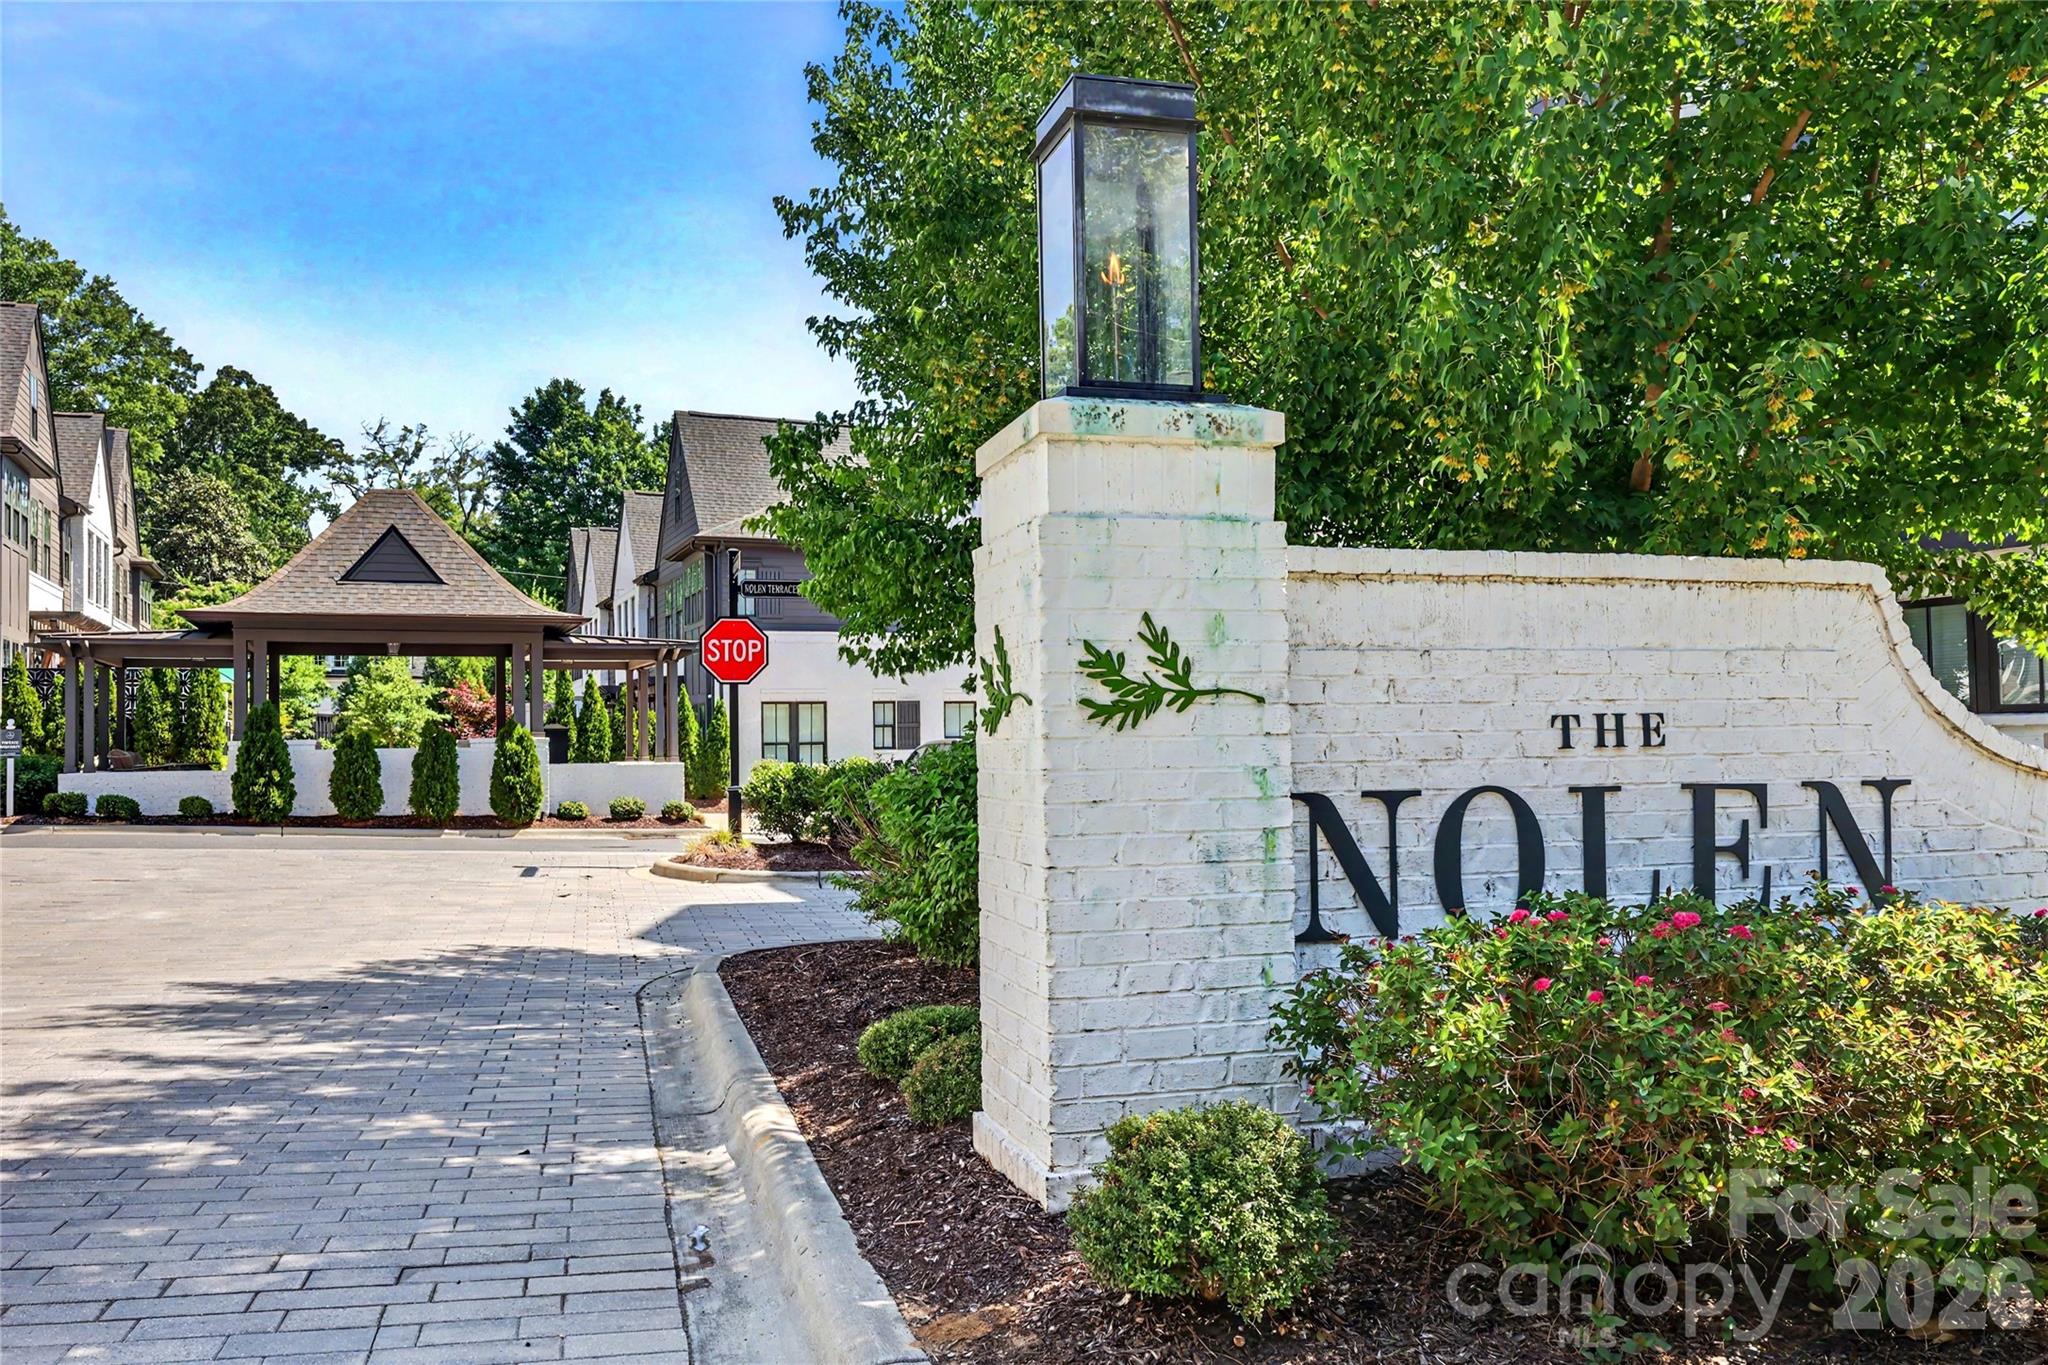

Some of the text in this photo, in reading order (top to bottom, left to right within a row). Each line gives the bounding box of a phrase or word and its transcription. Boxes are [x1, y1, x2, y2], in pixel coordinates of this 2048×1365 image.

[744, 584, 767, 594] NOLEN
[707, 639, 762, 662] STOP
[1551, 713, 1666, 749] THE
[1290, 777, 1912, 942] NOLEN
